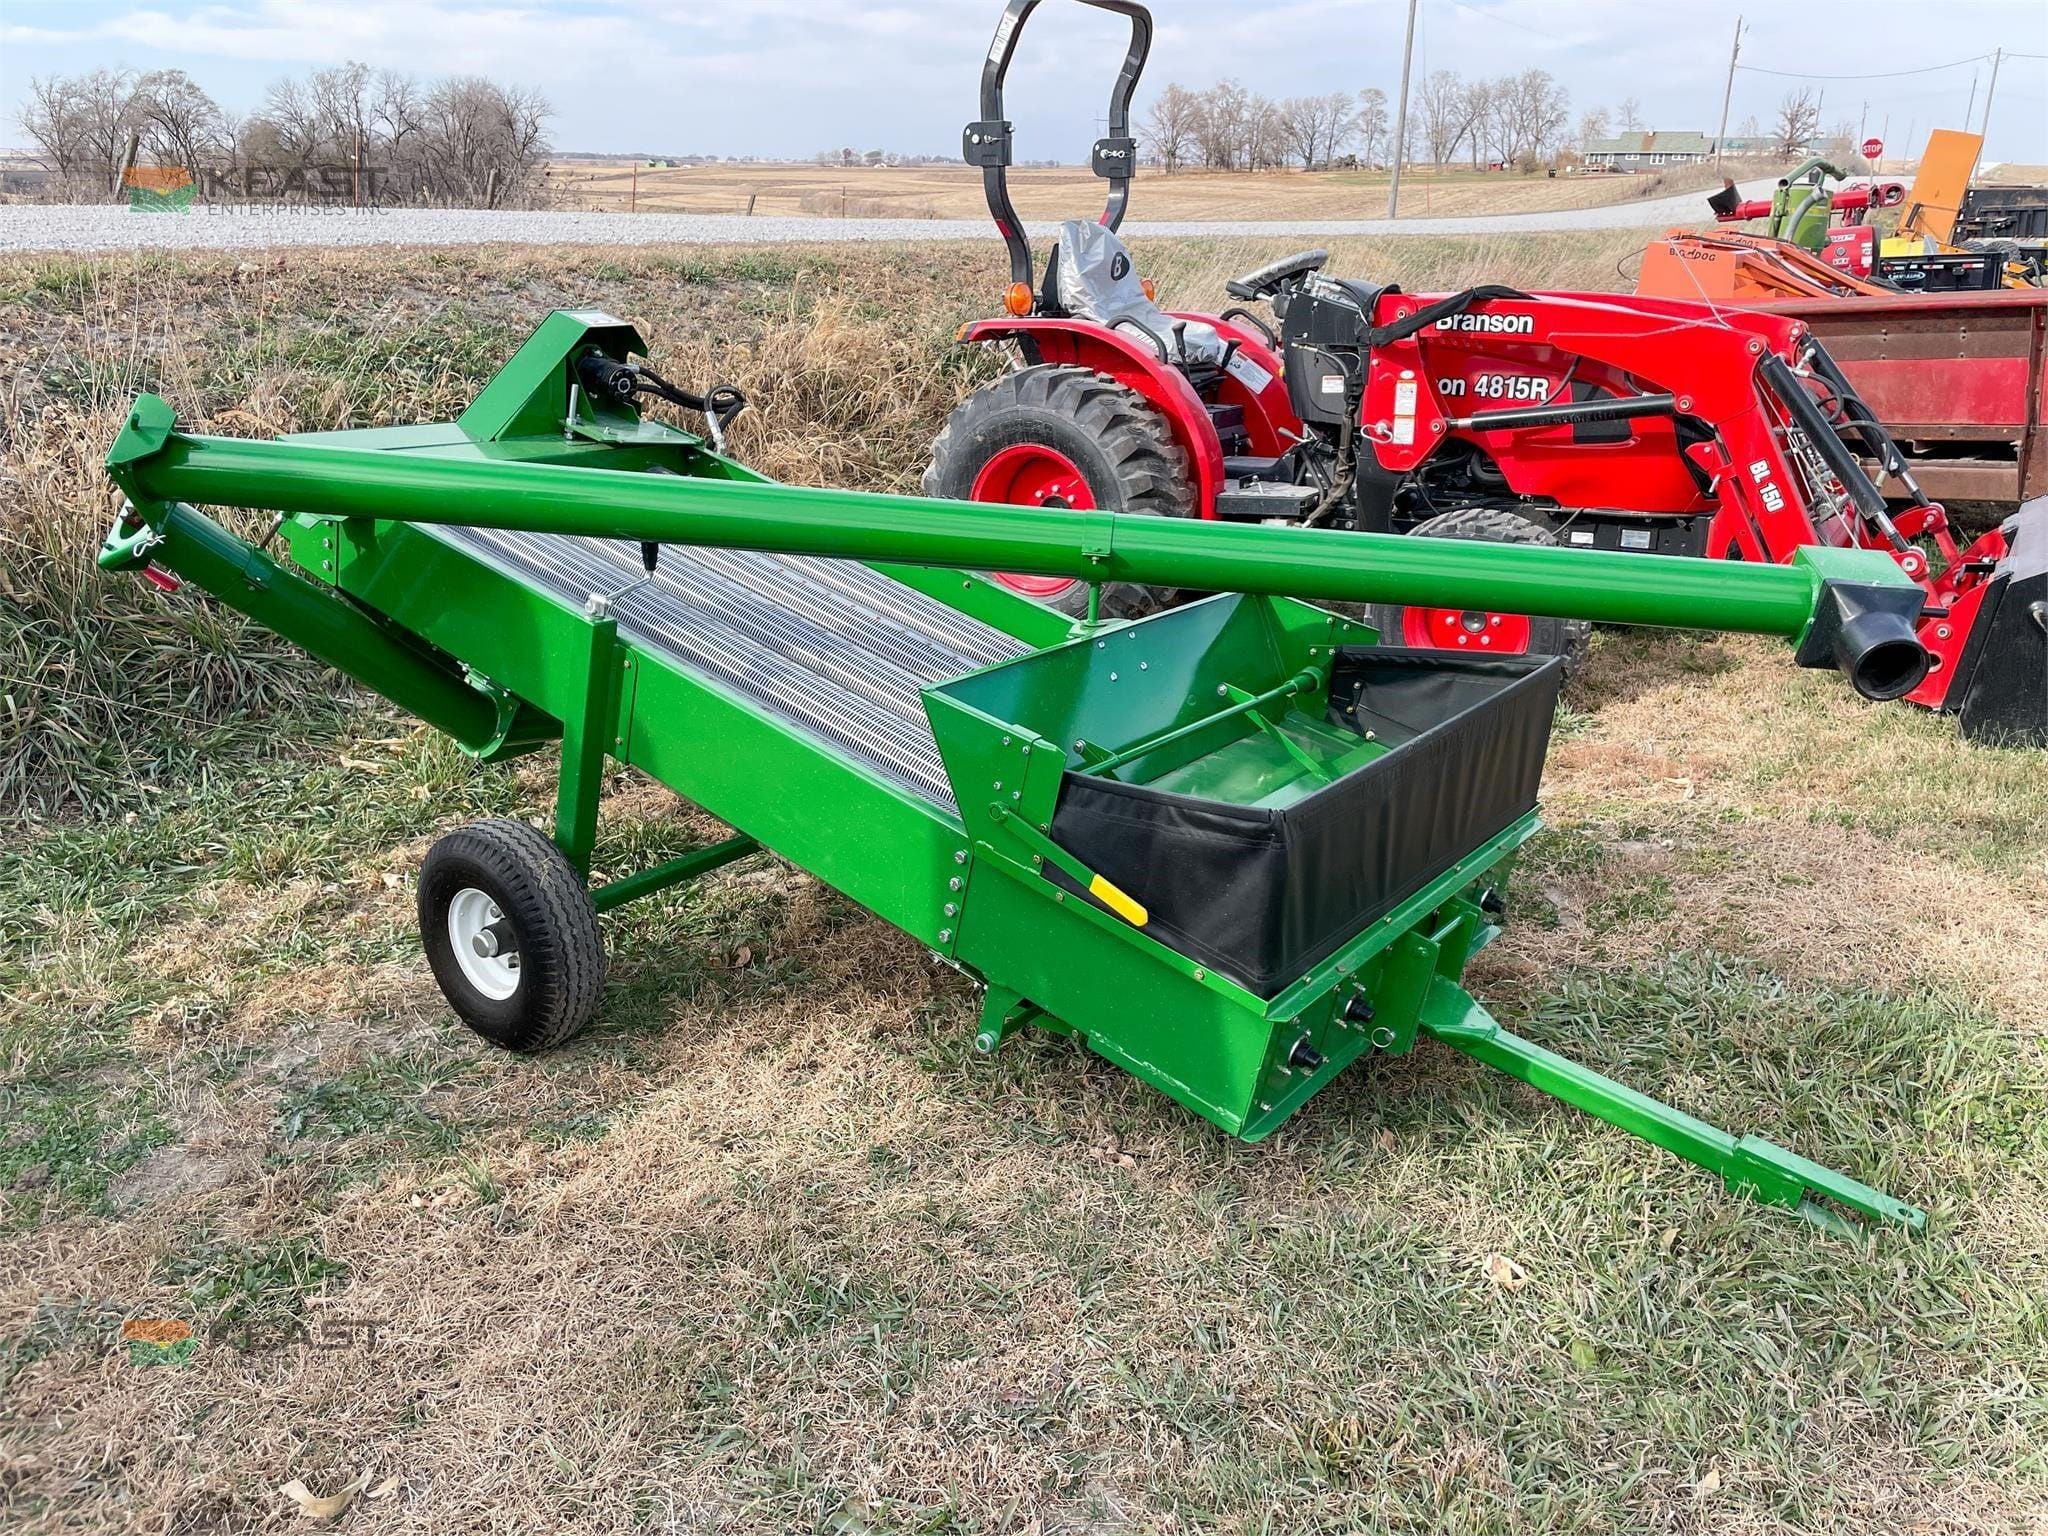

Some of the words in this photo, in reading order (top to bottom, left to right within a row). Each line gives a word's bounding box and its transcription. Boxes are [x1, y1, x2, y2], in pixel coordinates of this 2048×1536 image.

[1862, 144, 1882, 154] STOP
[1435, 313, 1534, 334] Branson
[1436, 377, 1466, 396] on
[1474, 375, 1550, 401] 4815R
[1749, 459, 1771, 484] BL
[1759, 481, 1785, 513] 150
